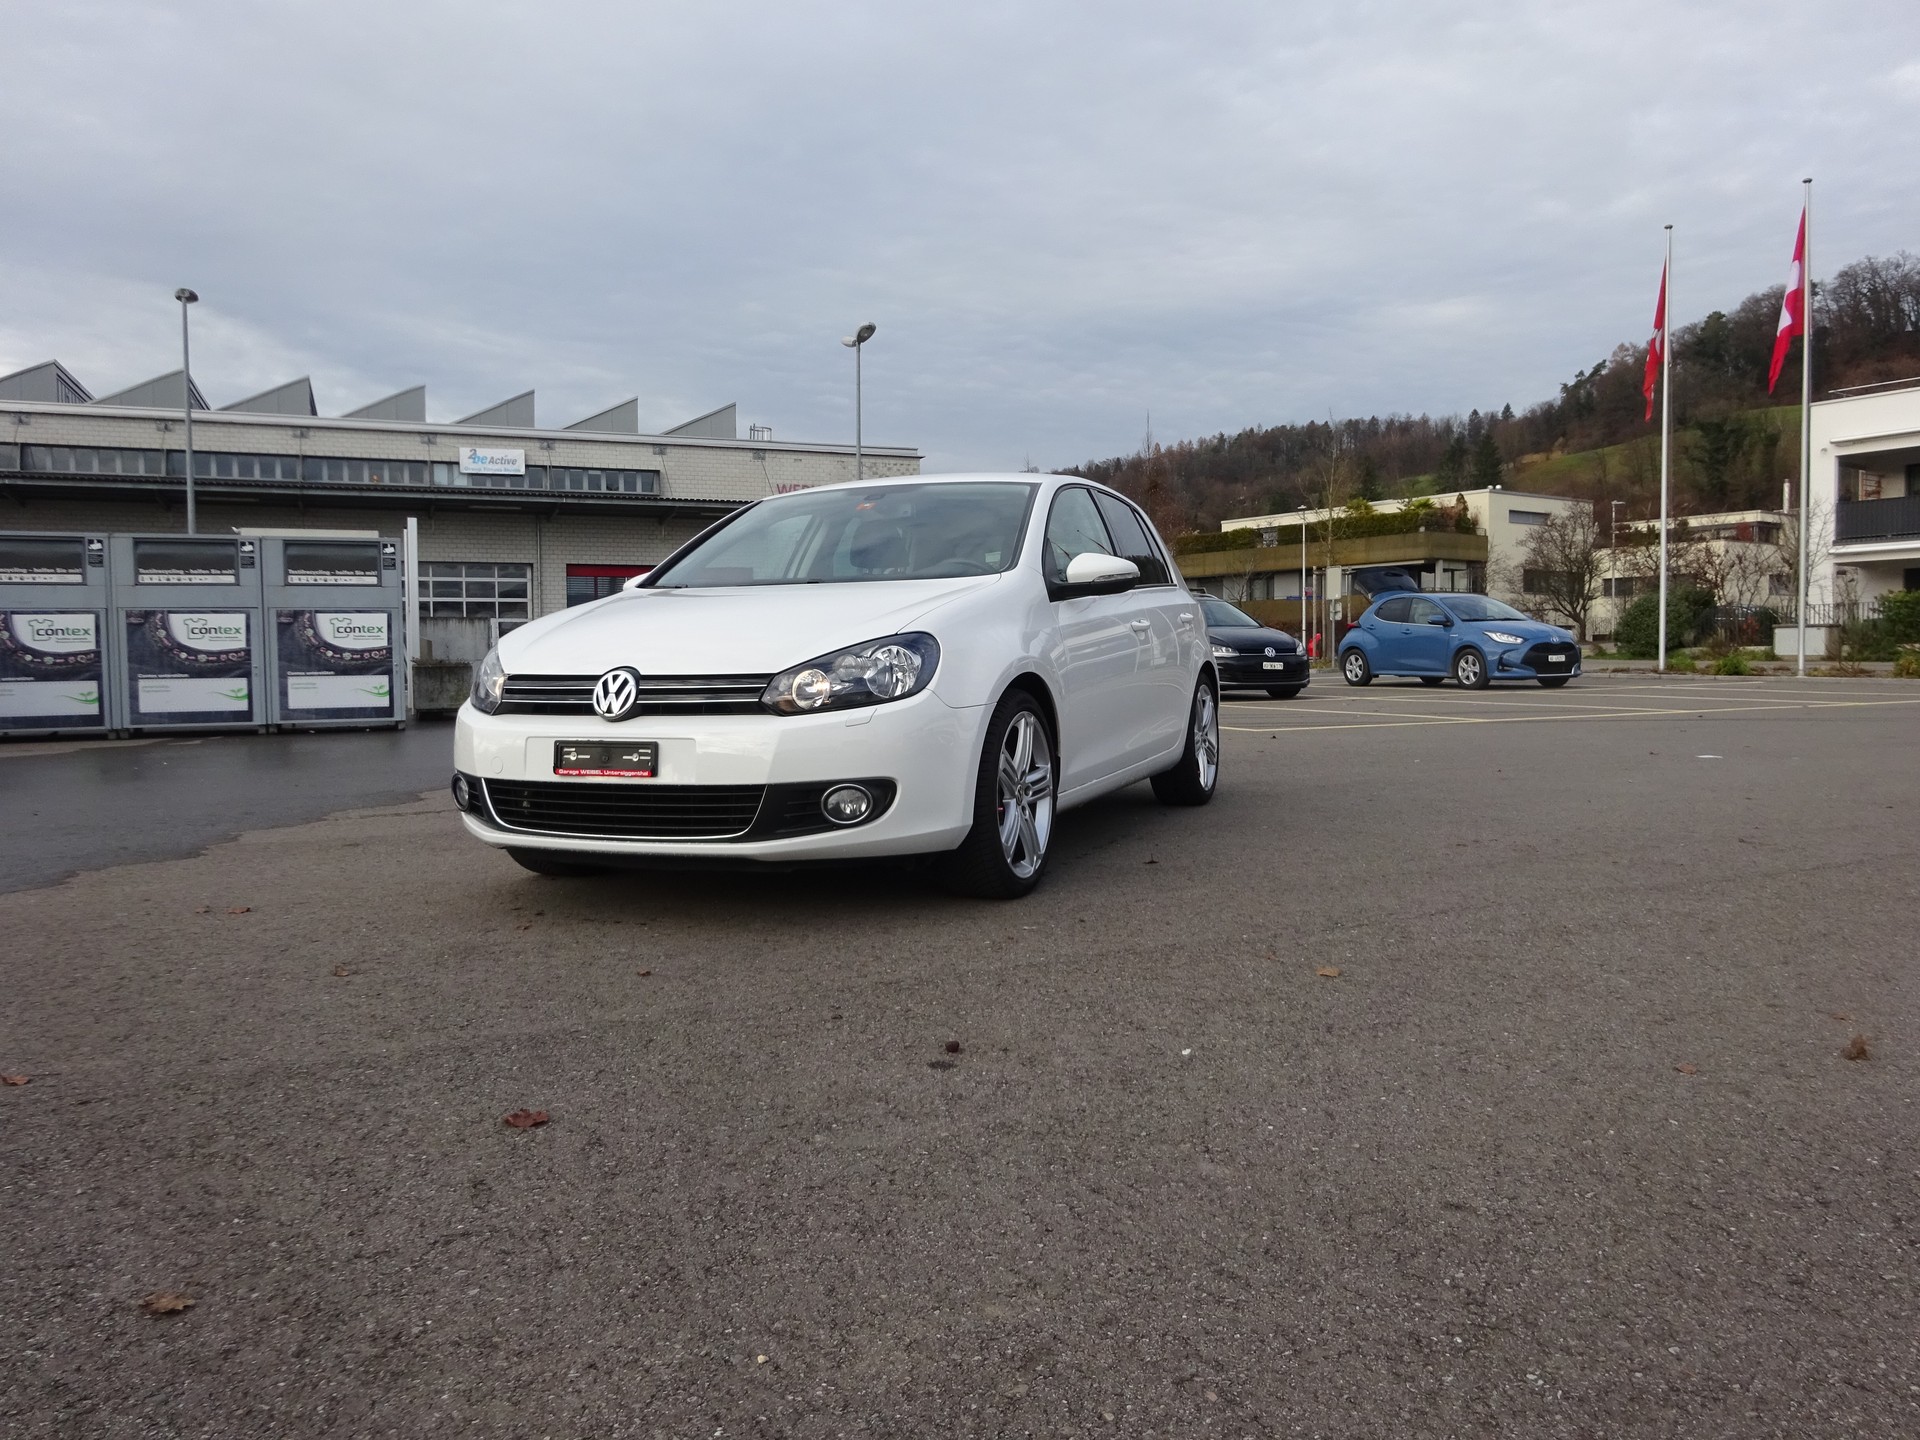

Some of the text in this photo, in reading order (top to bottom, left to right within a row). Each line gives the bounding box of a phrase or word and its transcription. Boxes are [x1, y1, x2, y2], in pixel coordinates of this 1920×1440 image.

[488, 455, 518, 466] Active
[36, 627, 91, 636] contex
[191, 626, 242, 635] contex
[336, 625, 384, 634] contex
[593, 670, 636, 717] VW
